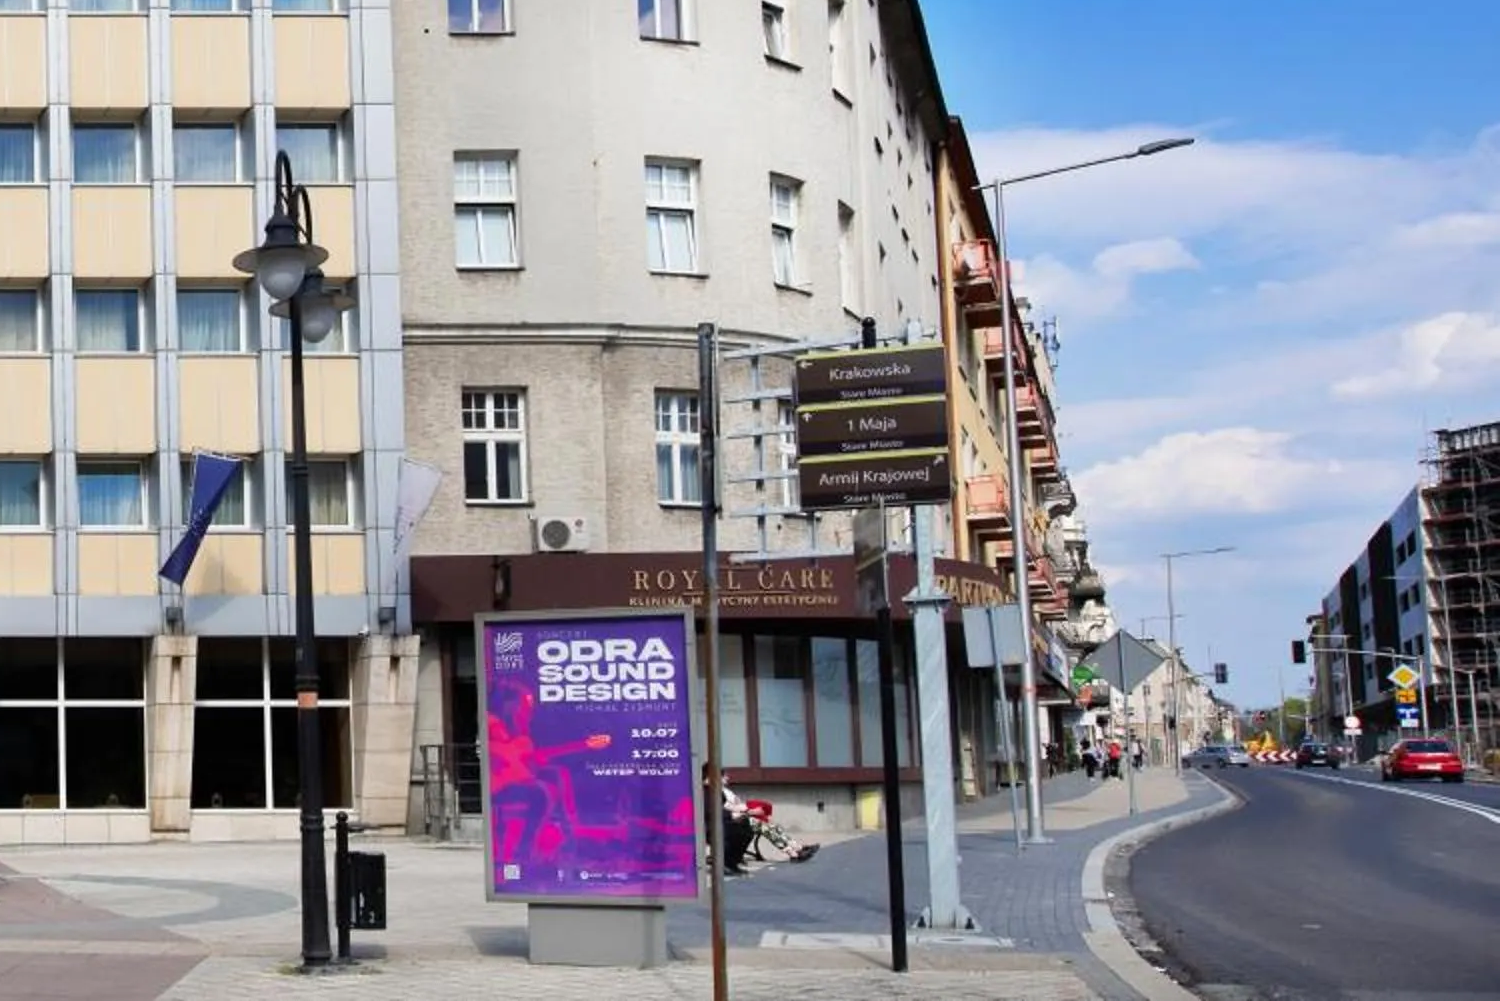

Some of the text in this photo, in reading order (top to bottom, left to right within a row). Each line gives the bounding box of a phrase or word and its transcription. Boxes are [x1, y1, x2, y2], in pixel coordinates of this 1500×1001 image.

[829, 363, 912, 381] Krakowska
[847, 417, 897, 432] 1 Maja
[863, 466, 931, 484] Krajowej
[634, 568, 834, 590] ROYL CARE
[537, 637, 675, 664] ODRA
[538, 662, 676, 683] SOUND
[539, 682, 677, 702] DESIGN
[631, 728, 678, 738] 10.07
[631, 750, 679, 758] 17:00
